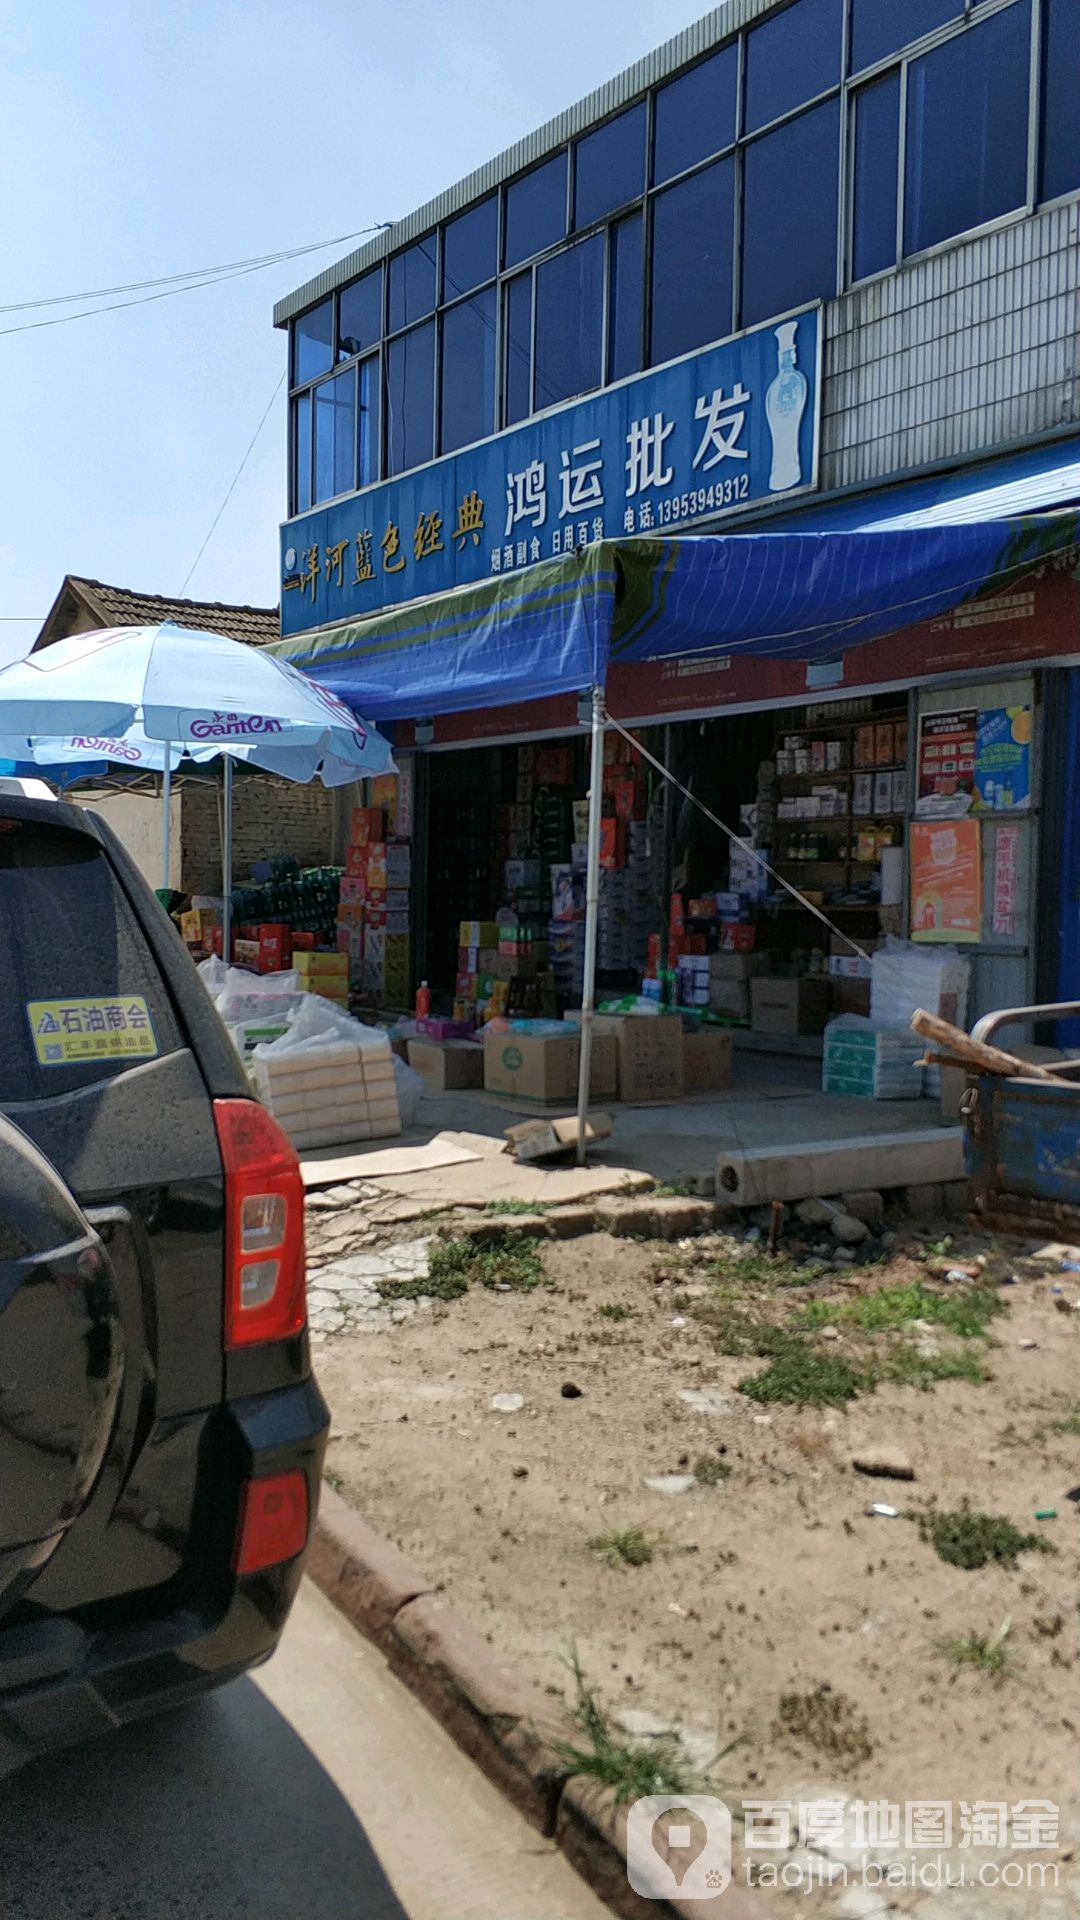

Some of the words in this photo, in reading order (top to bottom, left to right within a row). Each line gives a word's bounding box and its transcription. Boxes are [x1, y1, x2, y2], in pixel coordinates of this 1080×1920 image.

[504, 382, 751, 536] 鸿运批发
[490, 535, 541, 573] 烟酒副食
[552, 516, 605, 554] 日用百货
[59, 1003, 148, 1034] 石油商会
